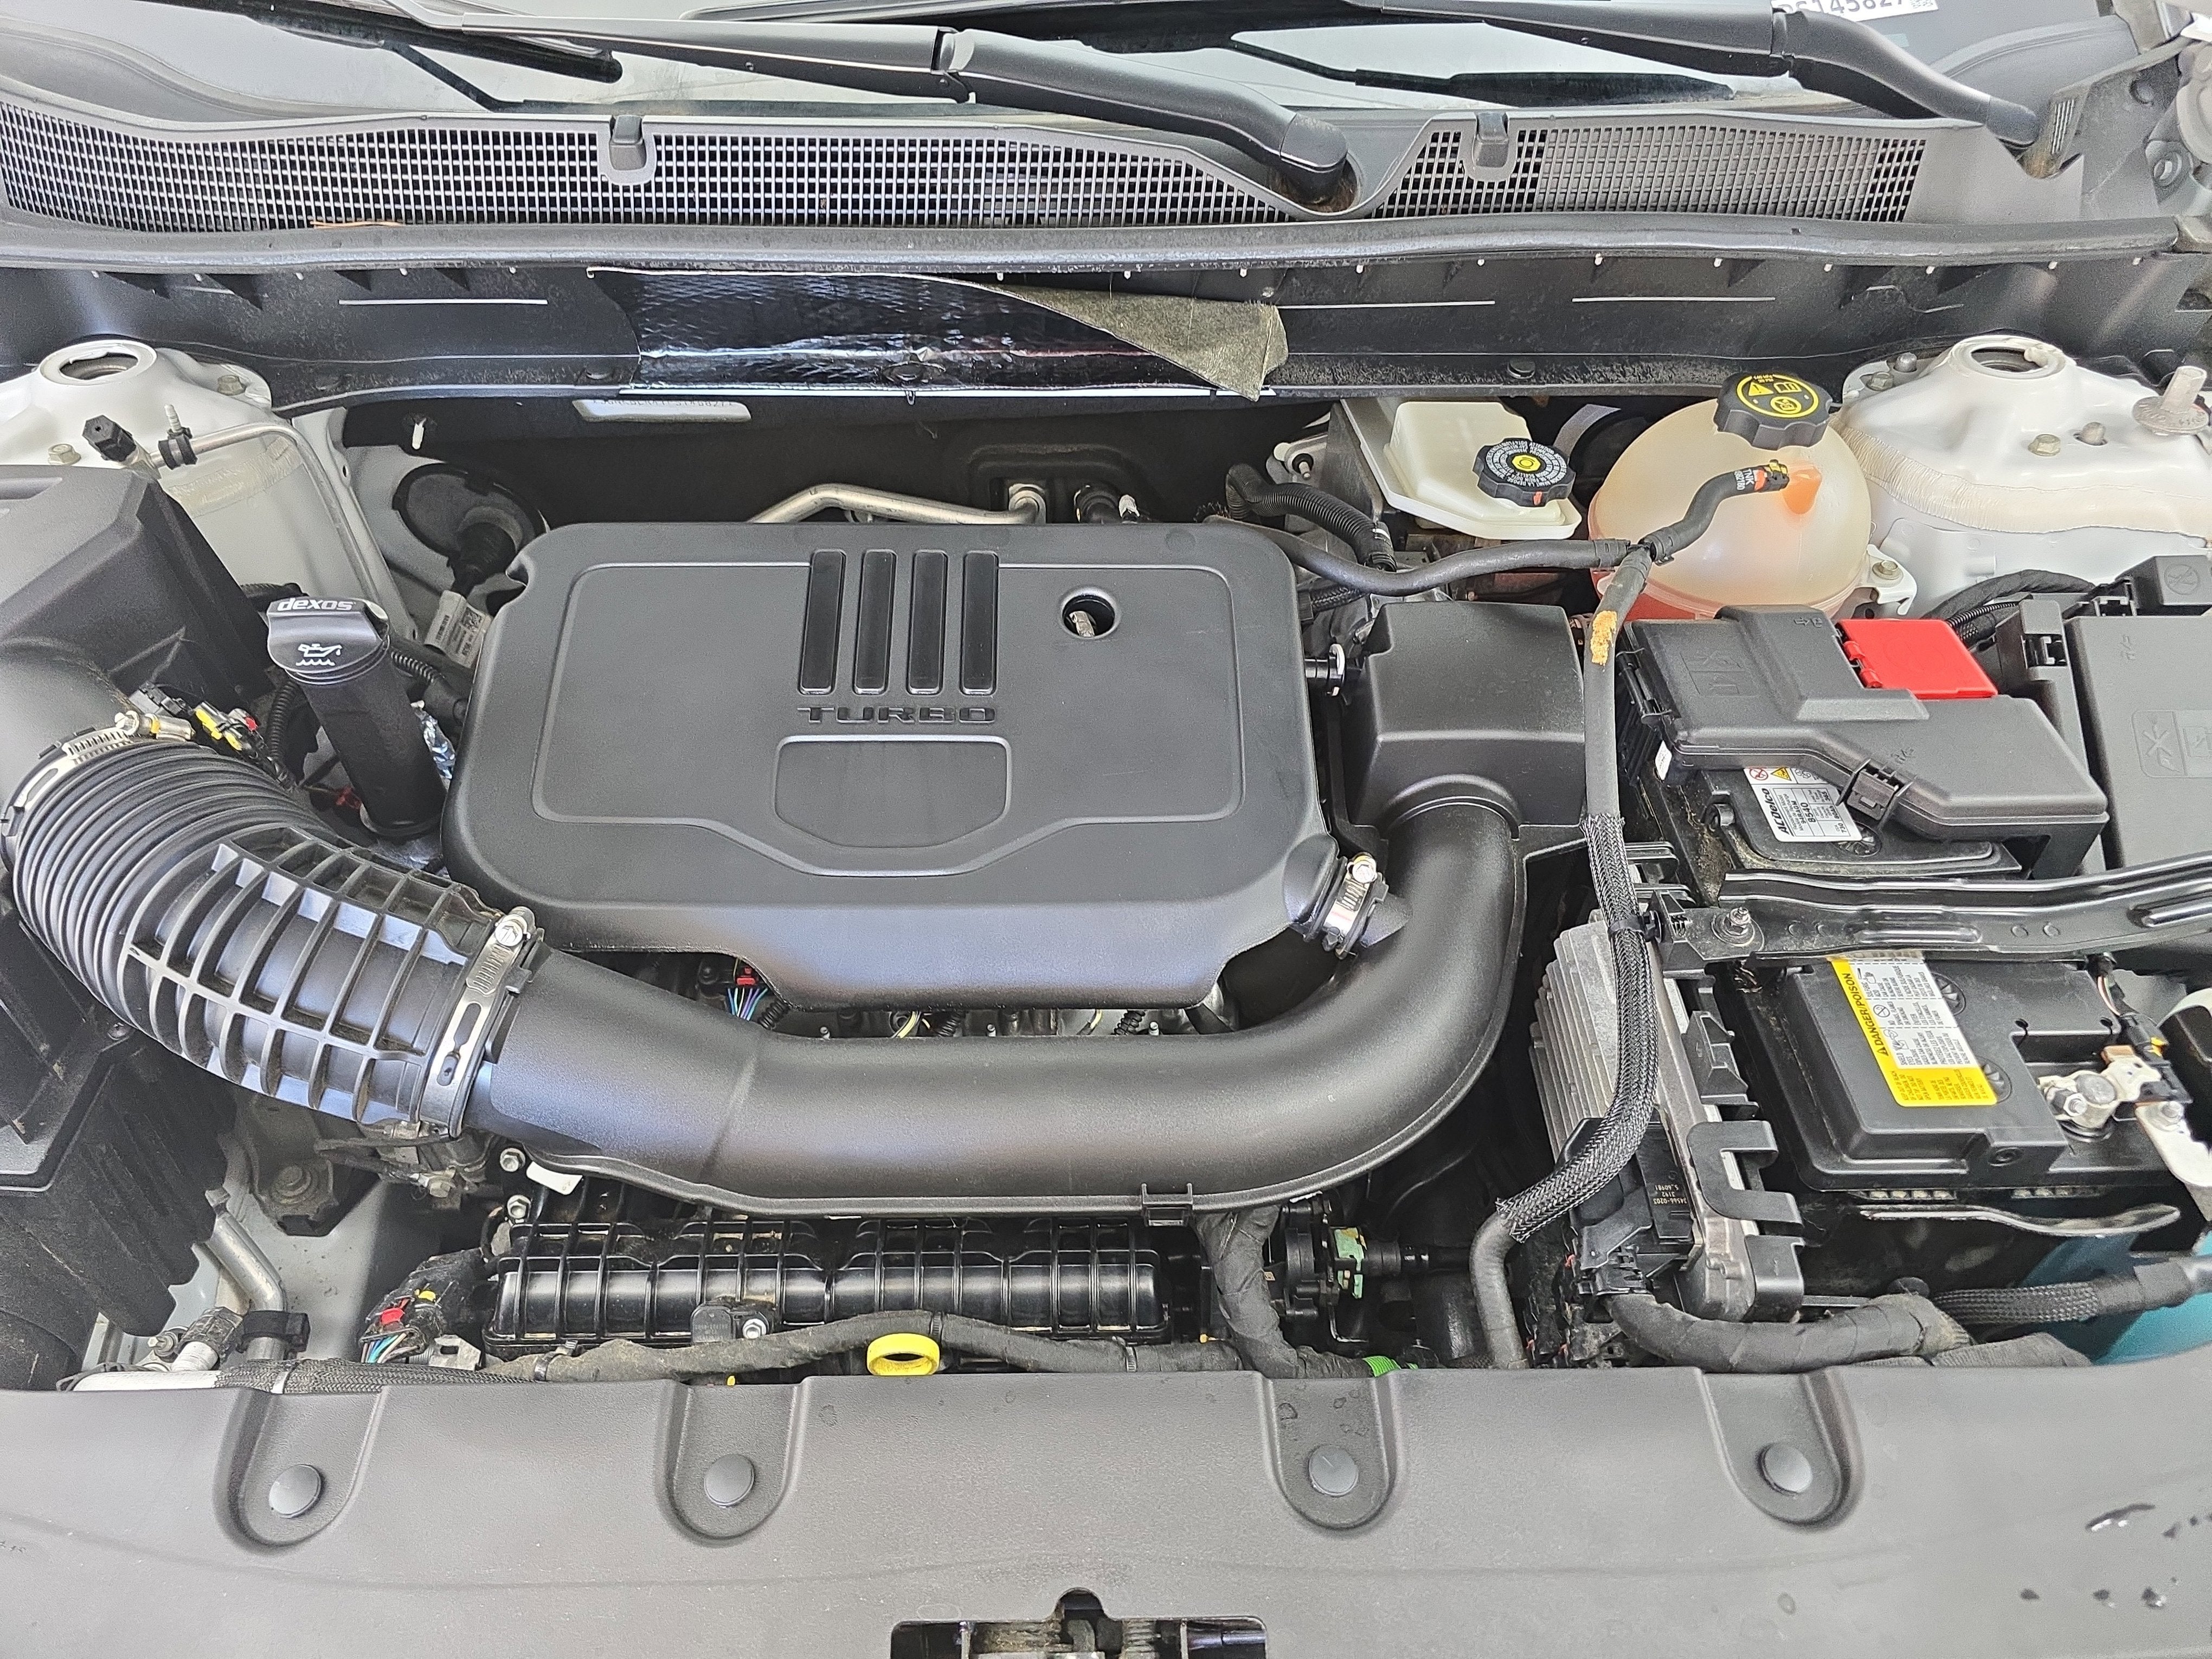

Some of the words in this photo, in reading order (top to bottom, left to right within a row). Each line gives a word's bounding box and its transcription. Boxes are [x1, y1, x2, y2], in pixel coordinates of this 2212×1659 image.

[1742, 468, 1755, 486] TNK
[277, 598, 353, 612] dexos
[797, 706, 995, 724] TURBO
[1759, 788, 1789, 834] ACDelco
[1791, 801, 1806, 823] 94RAGM
[1799, 802, 1816, 822] 8540
[1837, 823, 1847, 832] 730
[1842, 973, 1883, 1045] DANGER/POISON
